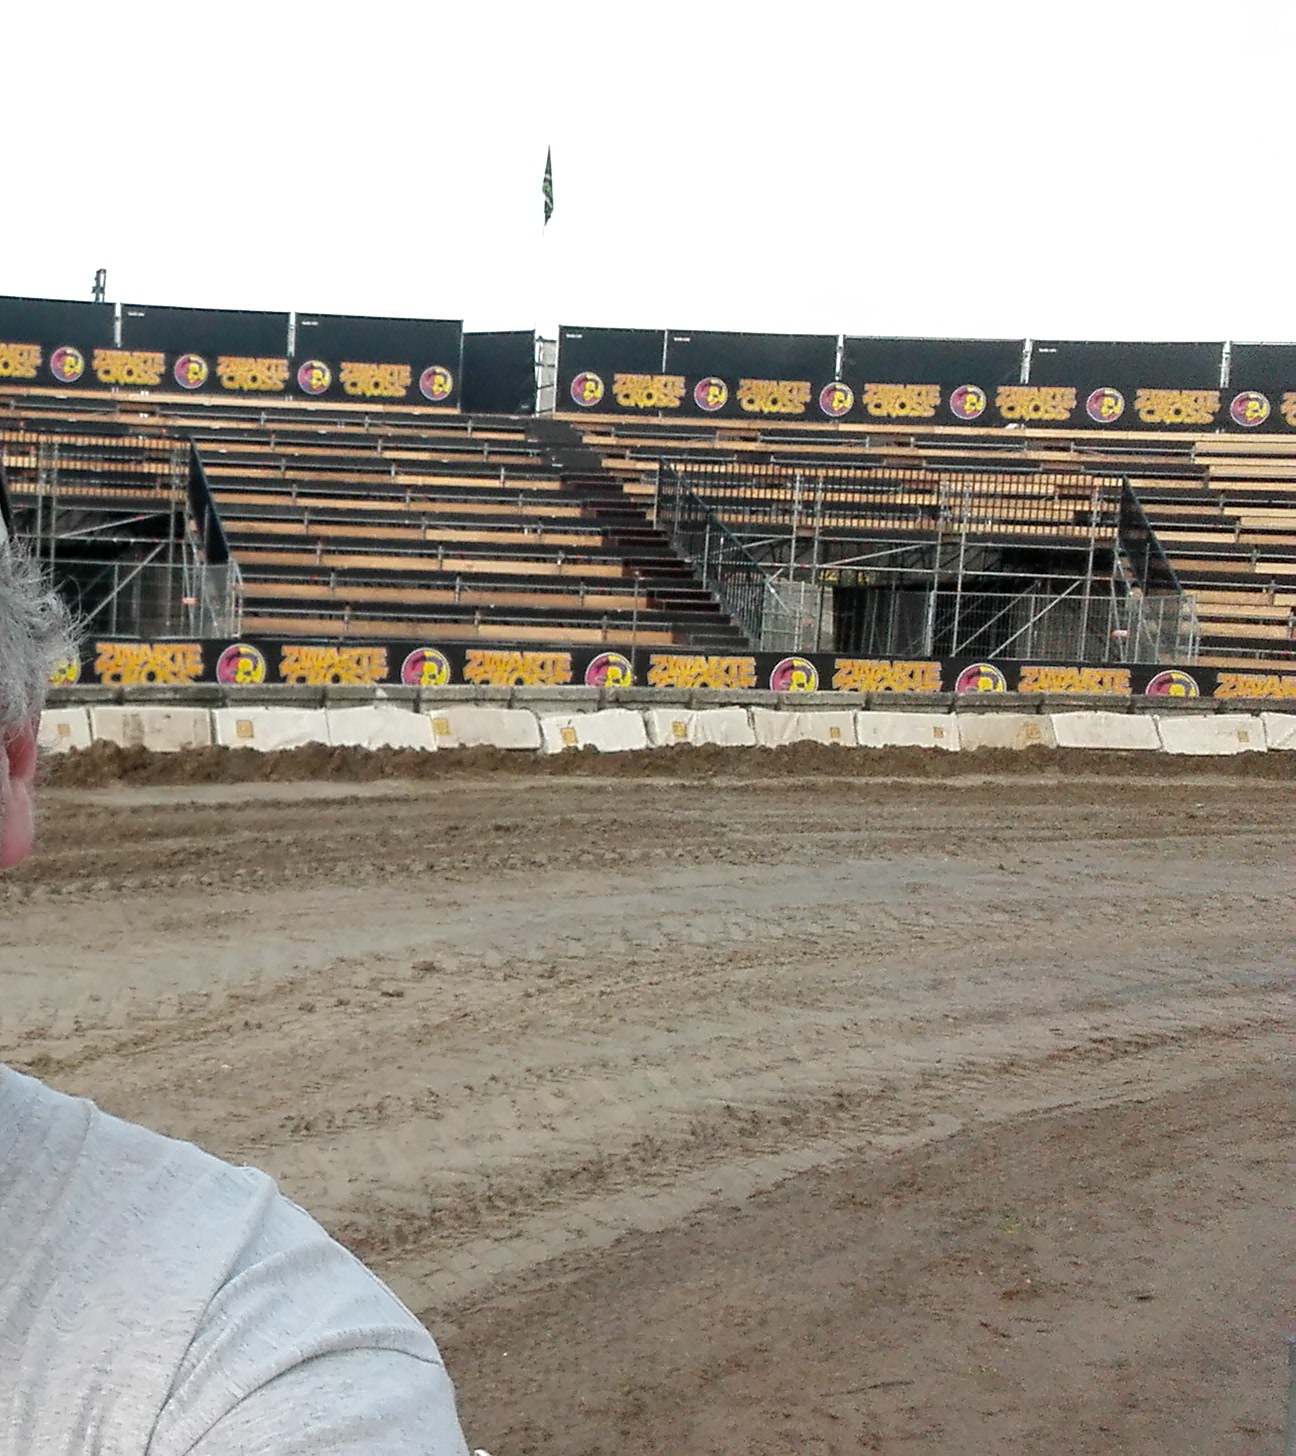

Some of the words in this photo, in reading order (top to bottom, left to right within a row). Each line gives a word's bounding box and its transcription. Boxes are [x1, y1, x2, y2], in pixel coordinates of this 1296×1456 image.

[94, 643, 204, 676] ZWARTE
[279, 645, 390, 680] ZWARTE
[463, 649, 573, 684] ZWARTE
[647, 653, 758, 687] ZWARTE
[831, 658, 943, 691] ZWARTE
[1018, 665, 1132, 695] ZWARTE
